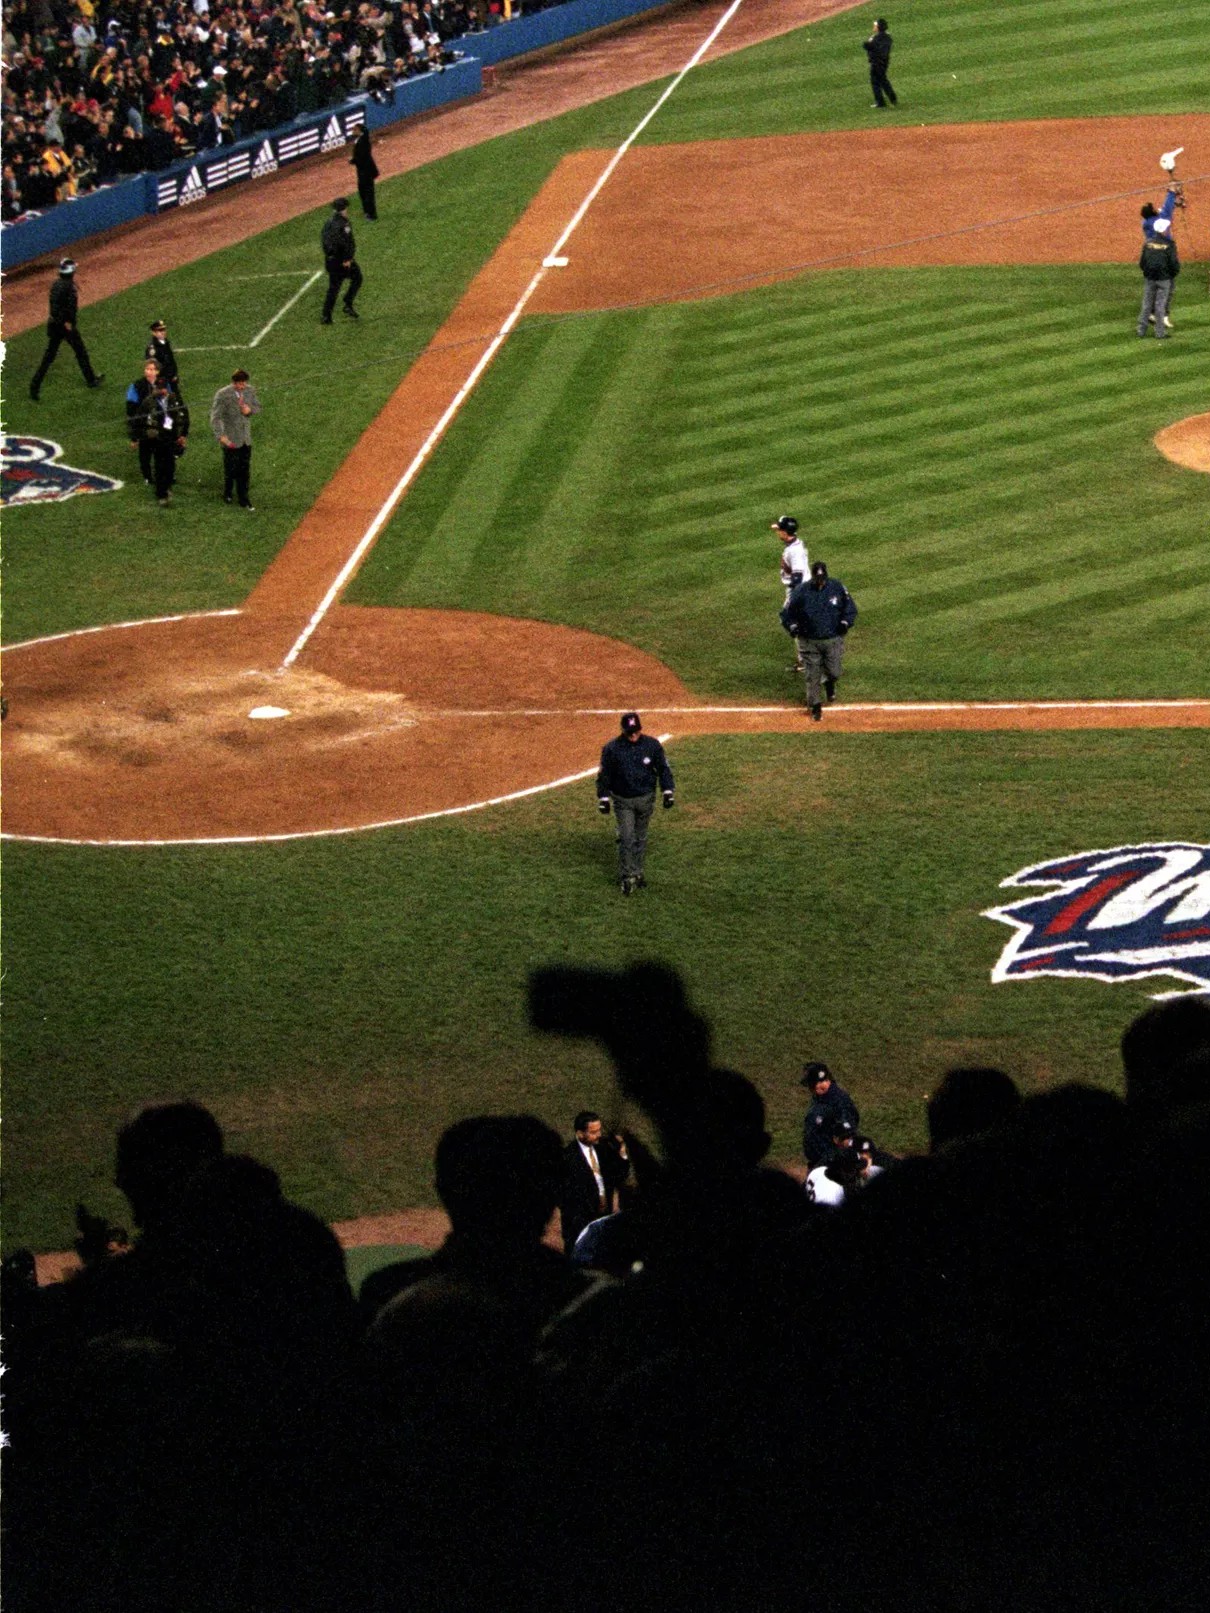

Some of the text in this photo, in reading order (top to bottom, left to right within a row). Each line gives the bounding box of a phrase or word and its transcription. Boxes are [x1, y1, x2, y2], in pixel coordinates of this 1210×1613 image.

[320, 135, 346, 152] adidas
[251, 160, 278, 179] adidas
[179, 187, 206, 206] adidas
